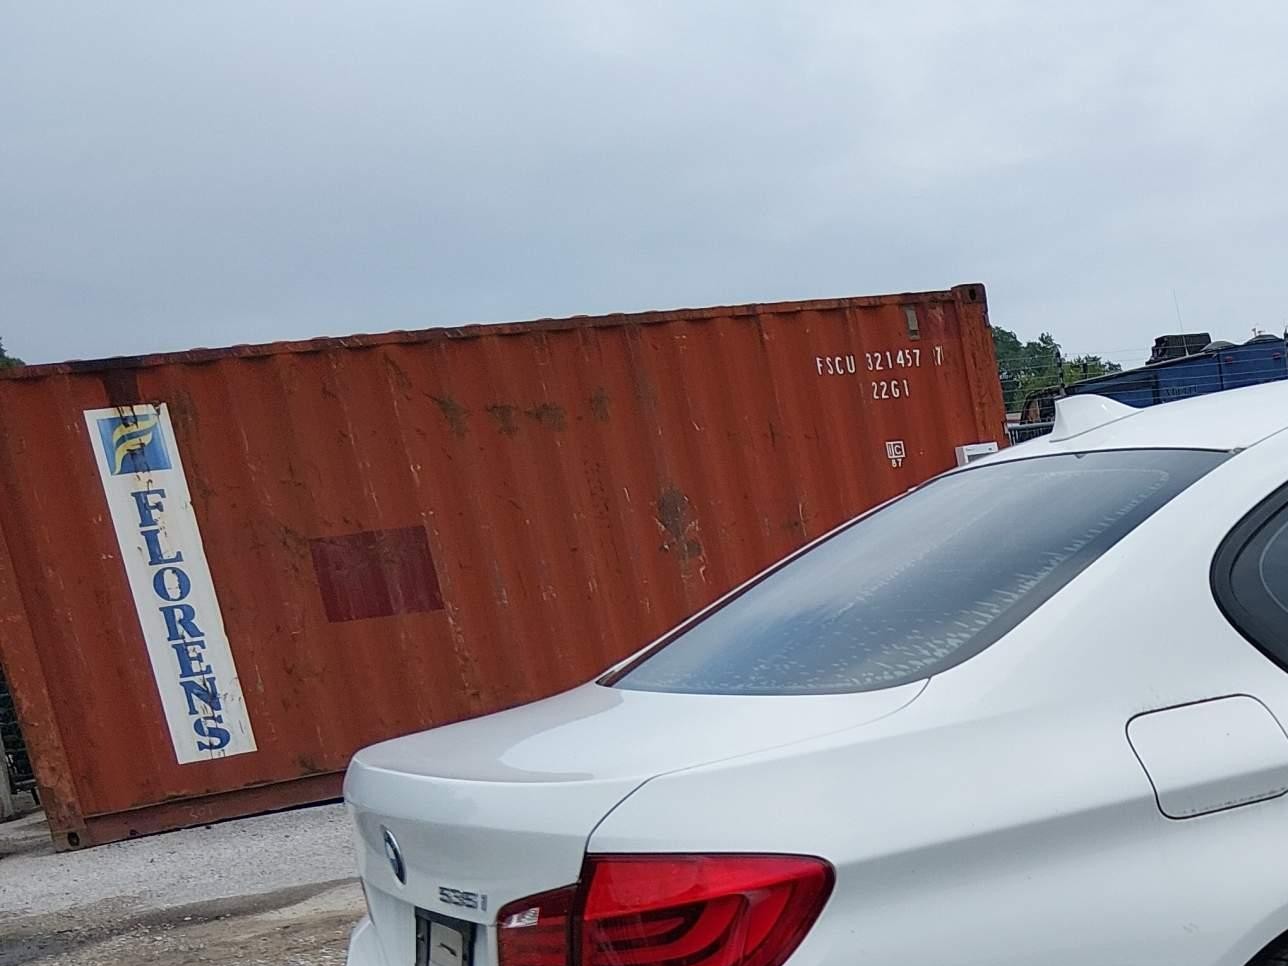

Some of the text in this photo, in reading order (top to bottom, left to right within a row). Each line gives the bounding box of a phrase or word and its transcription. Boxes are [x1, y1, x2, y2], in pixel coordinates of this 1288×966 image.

[815, 354, 856, 375] FSCU
[865, 348, 920, 371] 321457
[871, 379, 909, 399] 22G1
[130, 487, 232, 752] FLORENS
